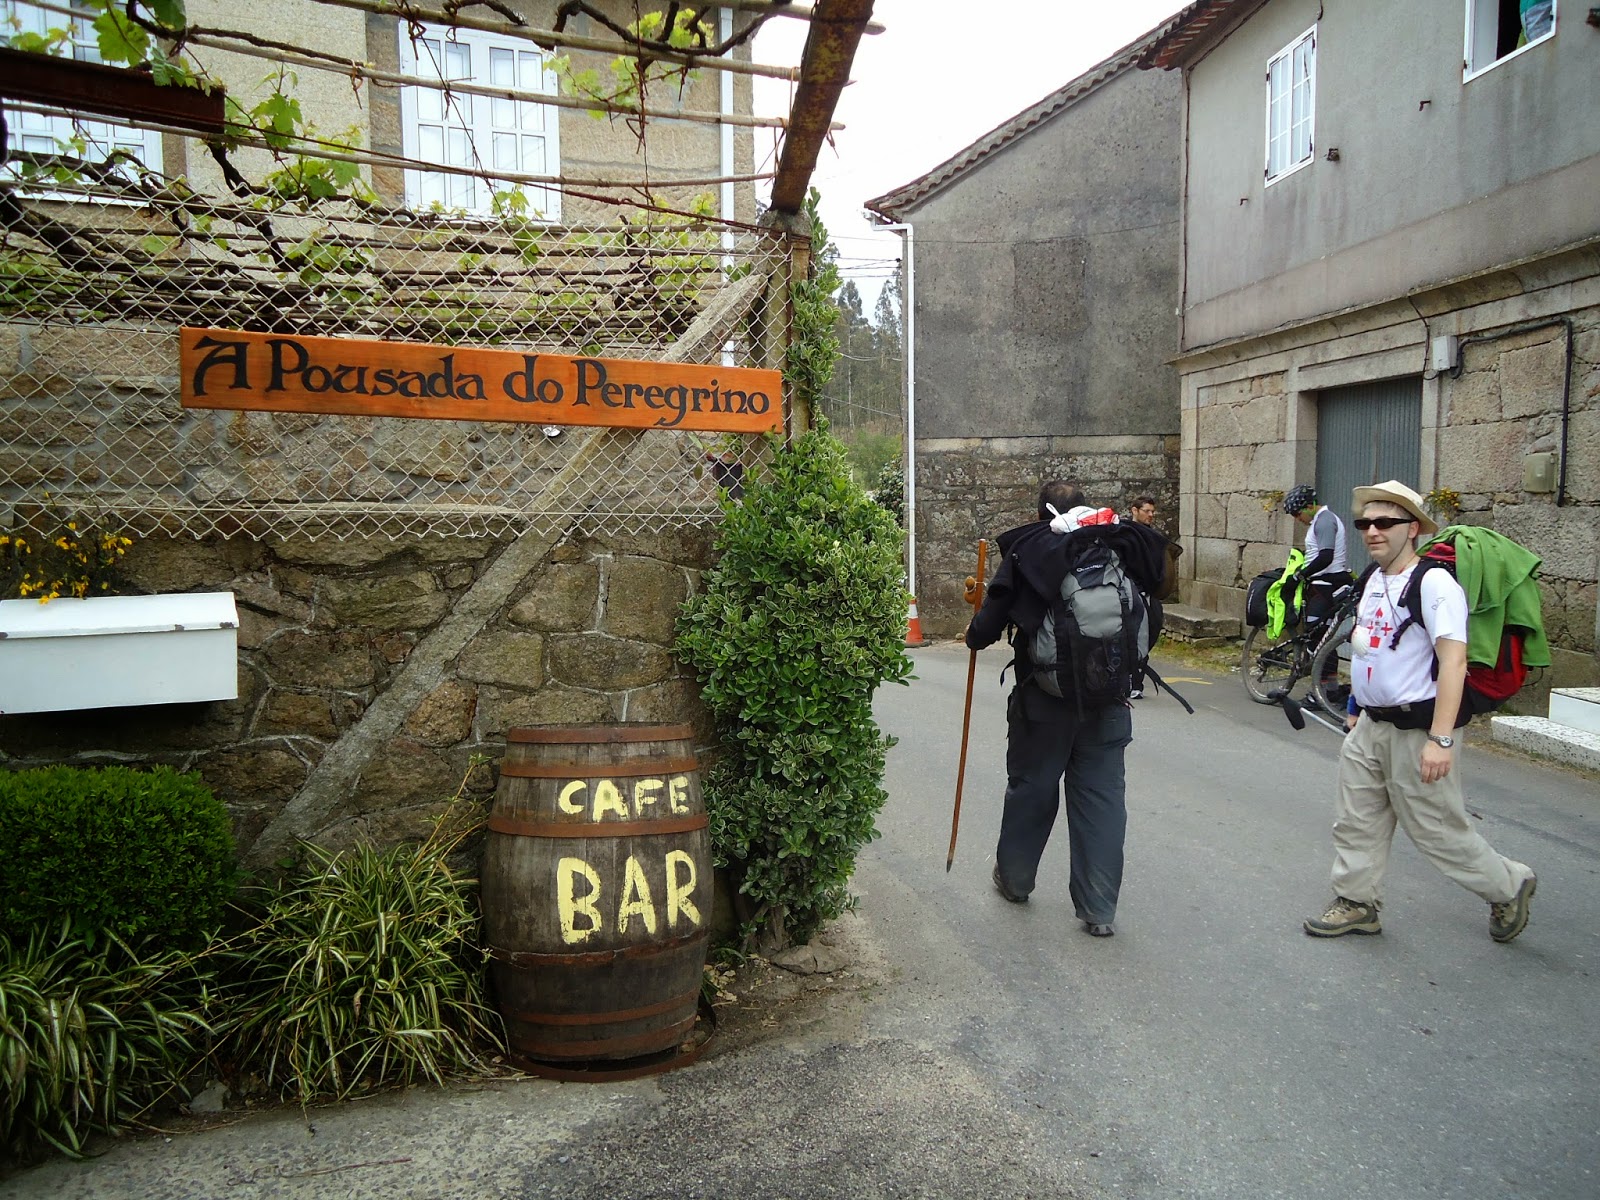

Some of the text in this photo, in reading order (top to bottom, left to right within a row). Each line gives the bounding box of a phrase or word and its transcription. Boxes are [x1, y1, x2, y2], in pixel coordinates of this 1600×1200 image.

[193, 336, 770, 426] A Pousada do Peregrino
[558, 776, 690, 822] CAFE
[557, 850, 701, 944] BAR
